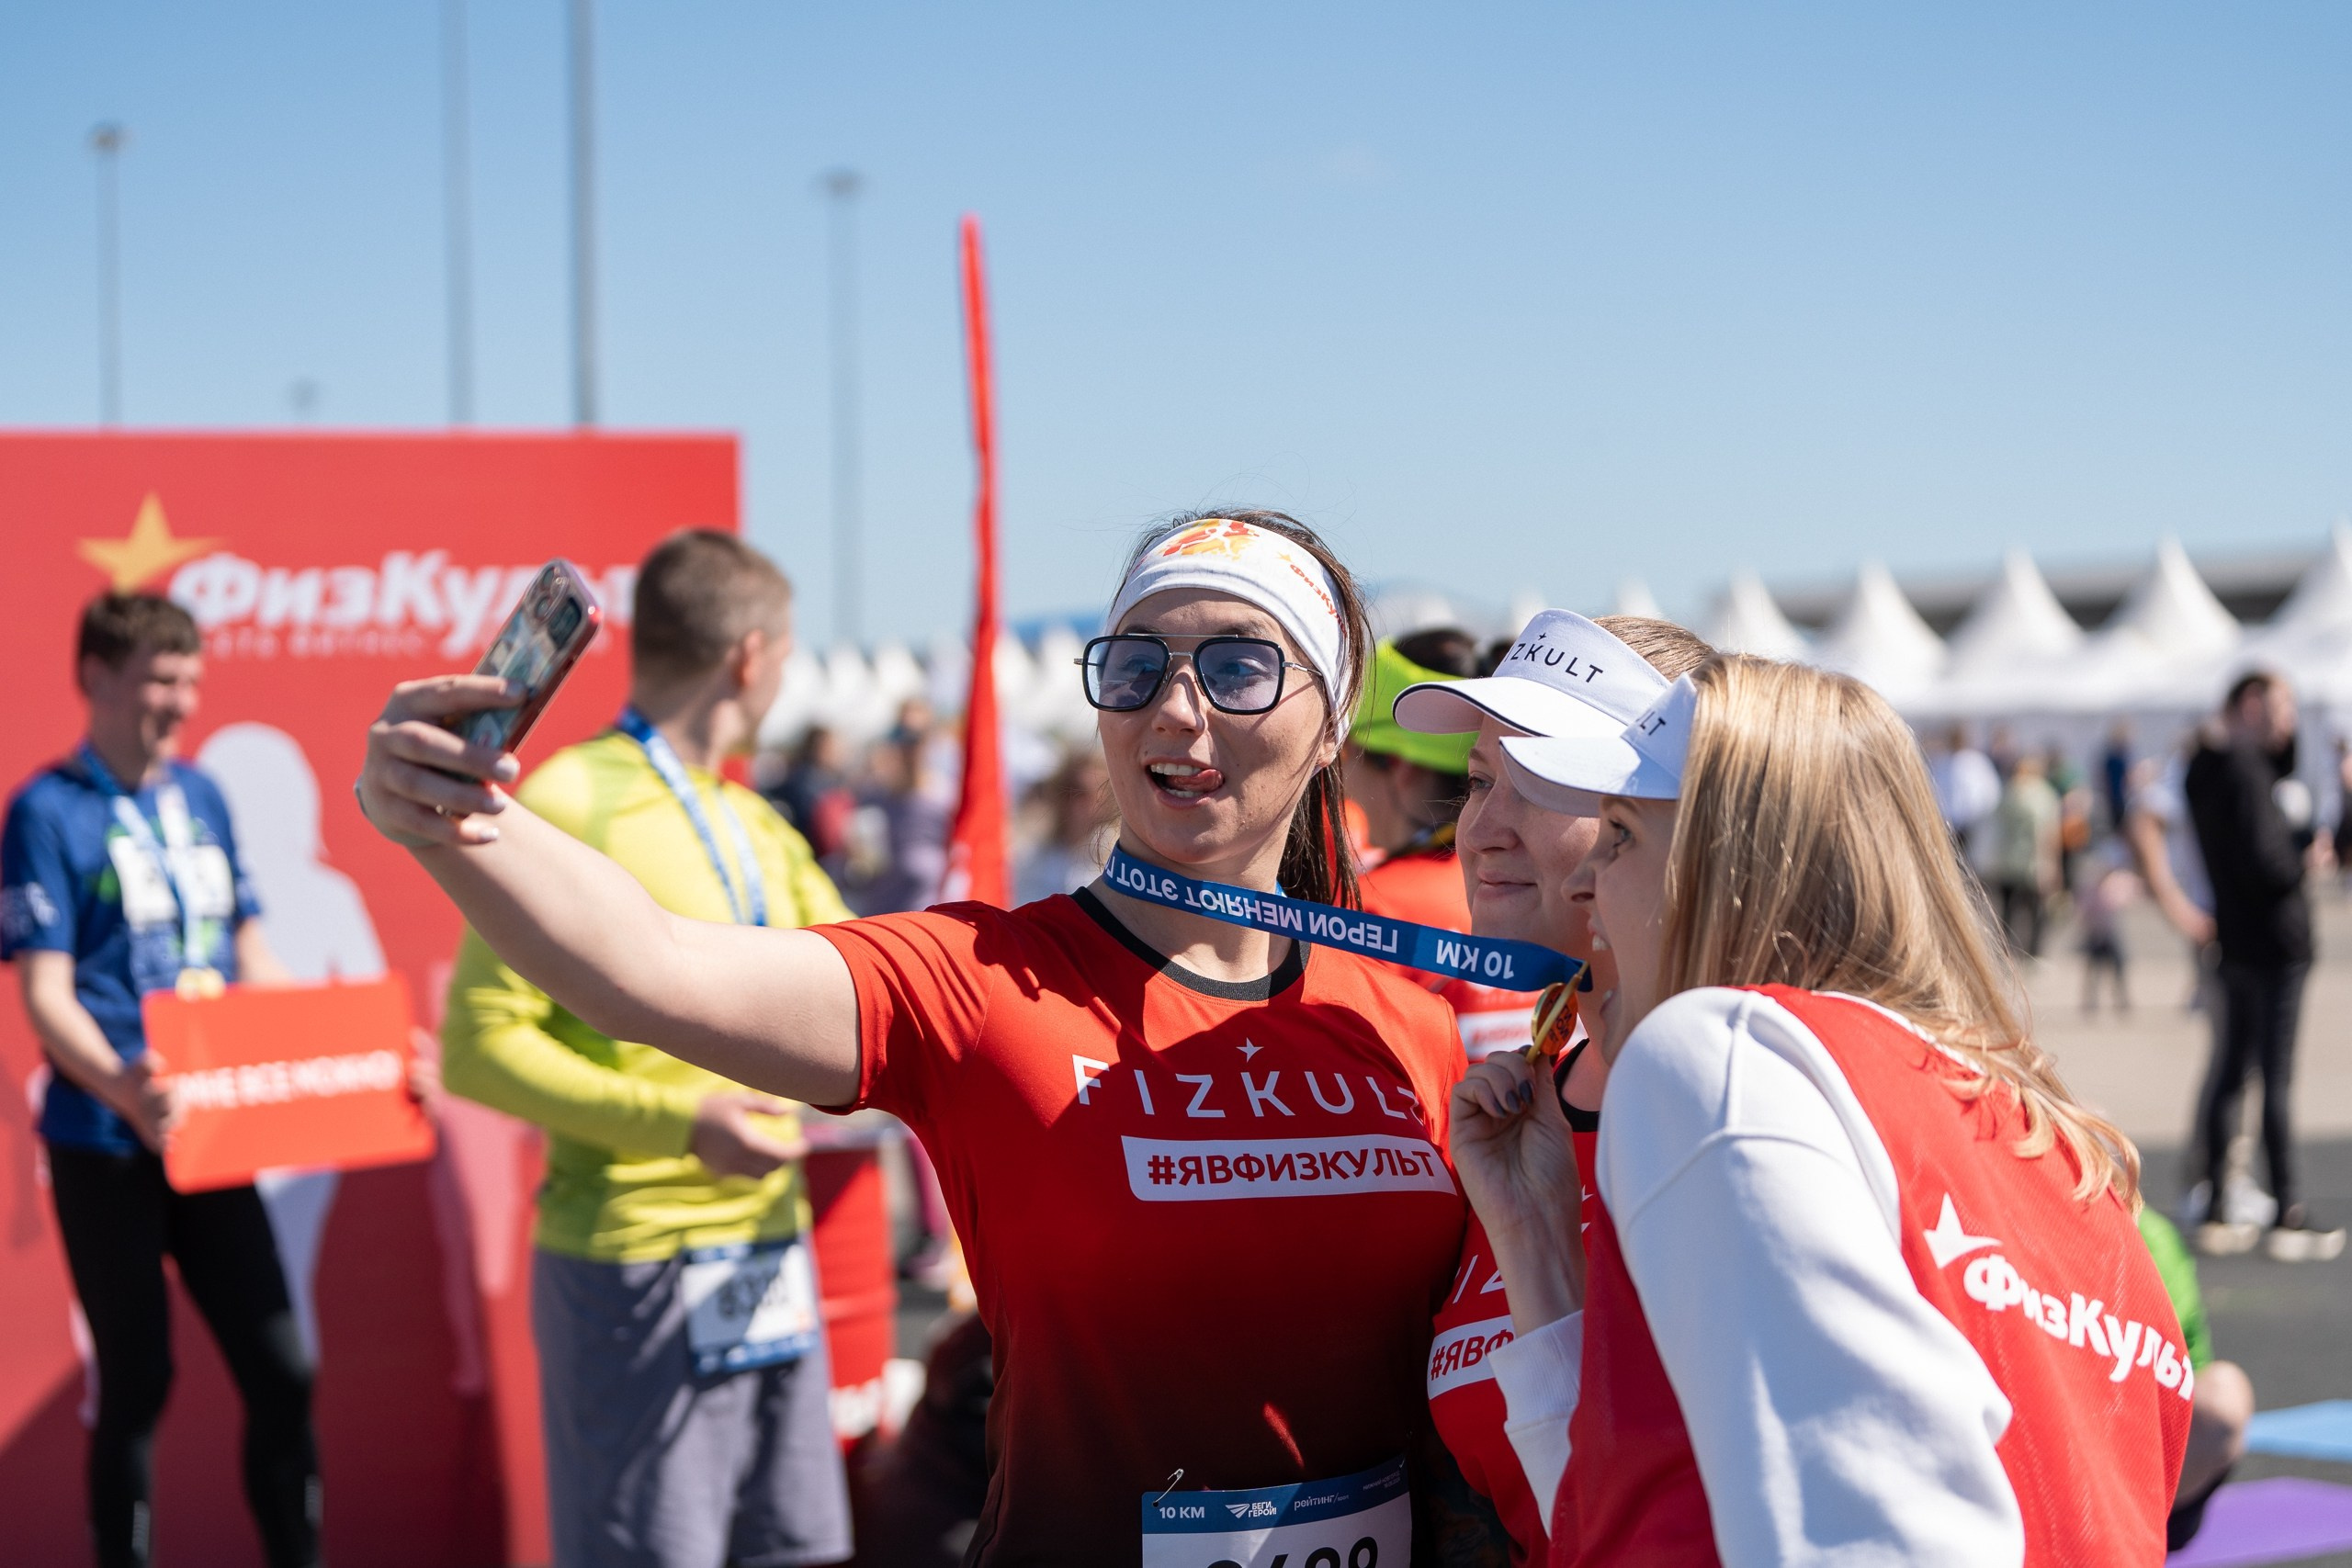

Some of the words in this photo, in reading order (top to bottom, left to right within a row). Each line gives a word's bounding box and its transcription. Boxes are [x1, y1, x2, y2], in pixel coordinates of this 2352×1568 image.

[168, 549, 636, 659] ФизКу
[1504, 642, 1604, 683] IZKULT
[1116, 863, 1179, 901] ЭТОТ
[1184, 886, 1303, 932] МЕНЯЮТ
[1308, 911, 1398, 954] ГЕРОИ
[1484, 951, 1515, 980] 10
[1148, 1147, 1436, 1186] #ЯВФИЗКУЛЬТ
[1159, 1506, 1176, 1518] 10
